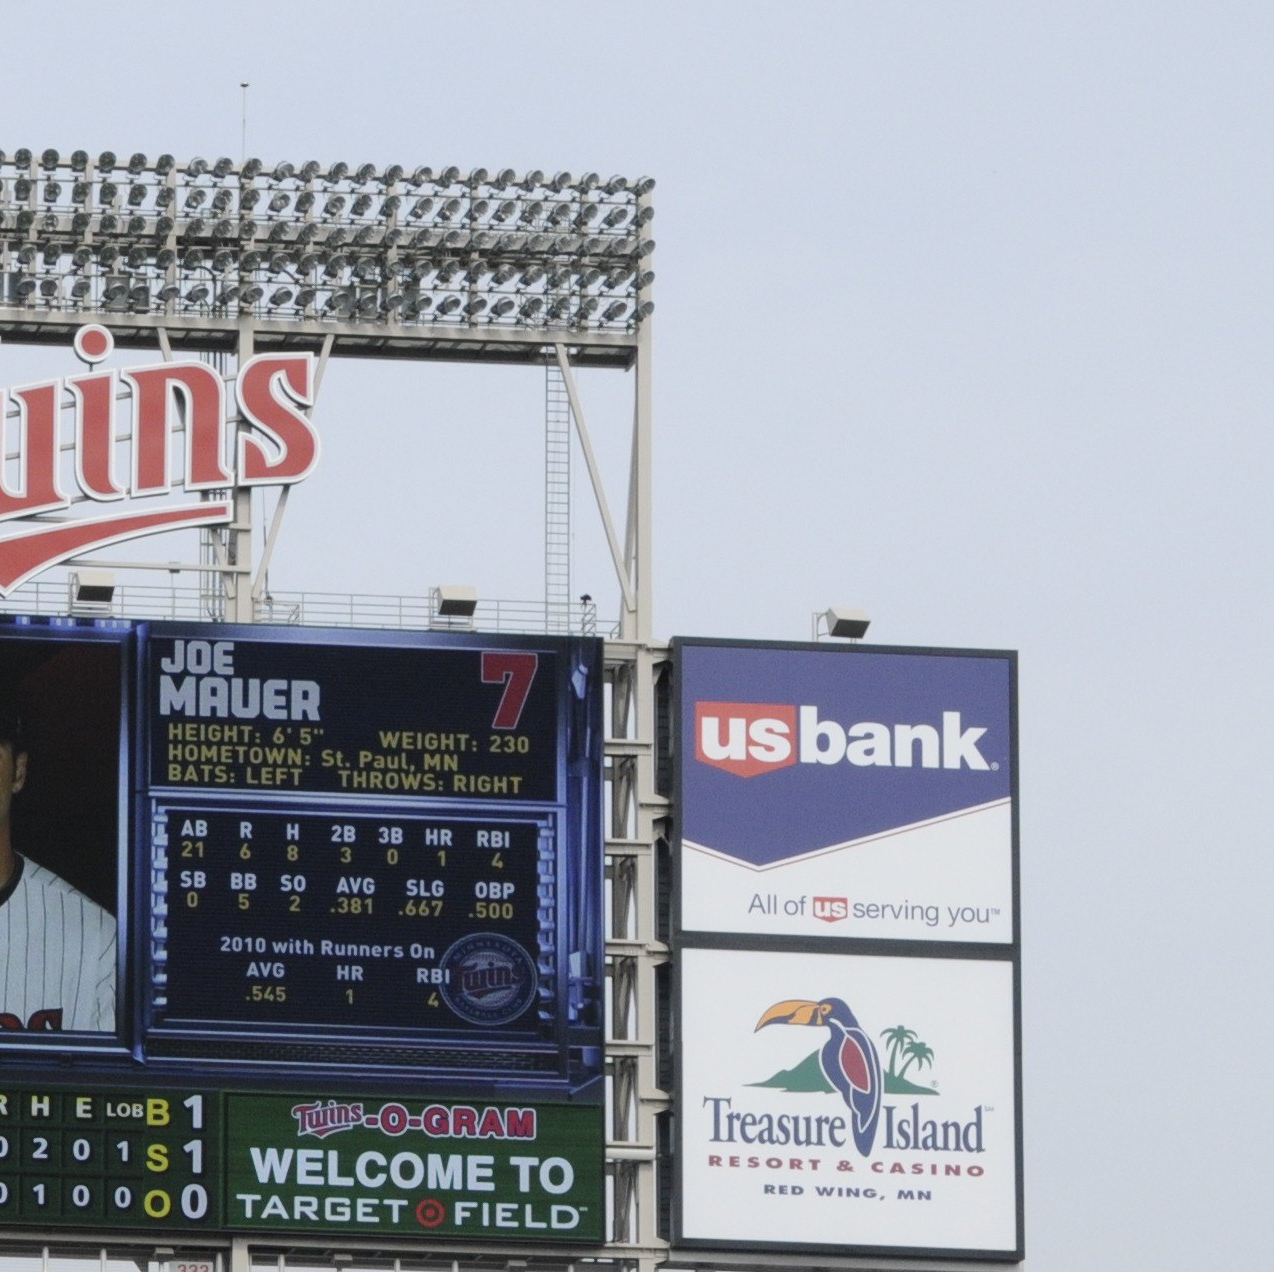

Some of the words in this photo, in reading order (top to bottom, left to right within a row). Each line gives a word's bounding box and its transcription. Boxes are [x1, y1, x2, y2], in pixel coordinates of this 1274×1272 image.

[161, 640, 234, 675] JOE
[160, 675, 320, 721] MAUER
[481, 653, 538, 728] 7
[169, 723, 260, 743] HEIGHT:
[379, 731, 477, 751] WEIGHT:
[490, 735, 528, 753] 230
[169, 744, 310, 765] HOMETOWN:
[322, 750, 350, 767] St.
[360, 751, 415, 772] Paul,
[424, 754, 457, 771] MN
[169, 764, 234, 783] BATS:
[247, 767, 302, 785] LEFT
[338, 770, 443, 791] THROWS:
[454, 775, 522, 793] RIGHT
[337, 877, 375, 894] AVG
[407, 879, 444, 897] SLG
[475, 882, 514, 899] OBP
[331, 897, 372, 914] .381
[399, 900, 443, 916] .667
[469, 902, 513, 919] .500
[748, 894, 776, 914] All
[784, 896, 806, 915] of
[815, 900, 847, 918] us
[853, 903, 939, 926] serving
[221, 936, 266, 953] 2010
[272, 939, 314, 954] with
[321, 940, 403, 958] Runners
[410, 943, 434, 959] On
[703, 1096, 846, 1147] Treasure
[883, 1103, 985, 1153] Island
[250, 1147, 495, 1191] WELCOME
[510, 1157, 574, 1194] TO
[709, 1155, 820, 1170] RESORT
[837, 1161, 853, 1171] &
[871, 1162, 984, 1176] CASINO
[764, 1185, 804, 1195] RED
[816, 1187, 884, 1200] WING,
[898, 1190, 931, 1200] MN
[236, 1194, 408, 1223] TARGET
[455, 1202, 579, 1229] FIELD
